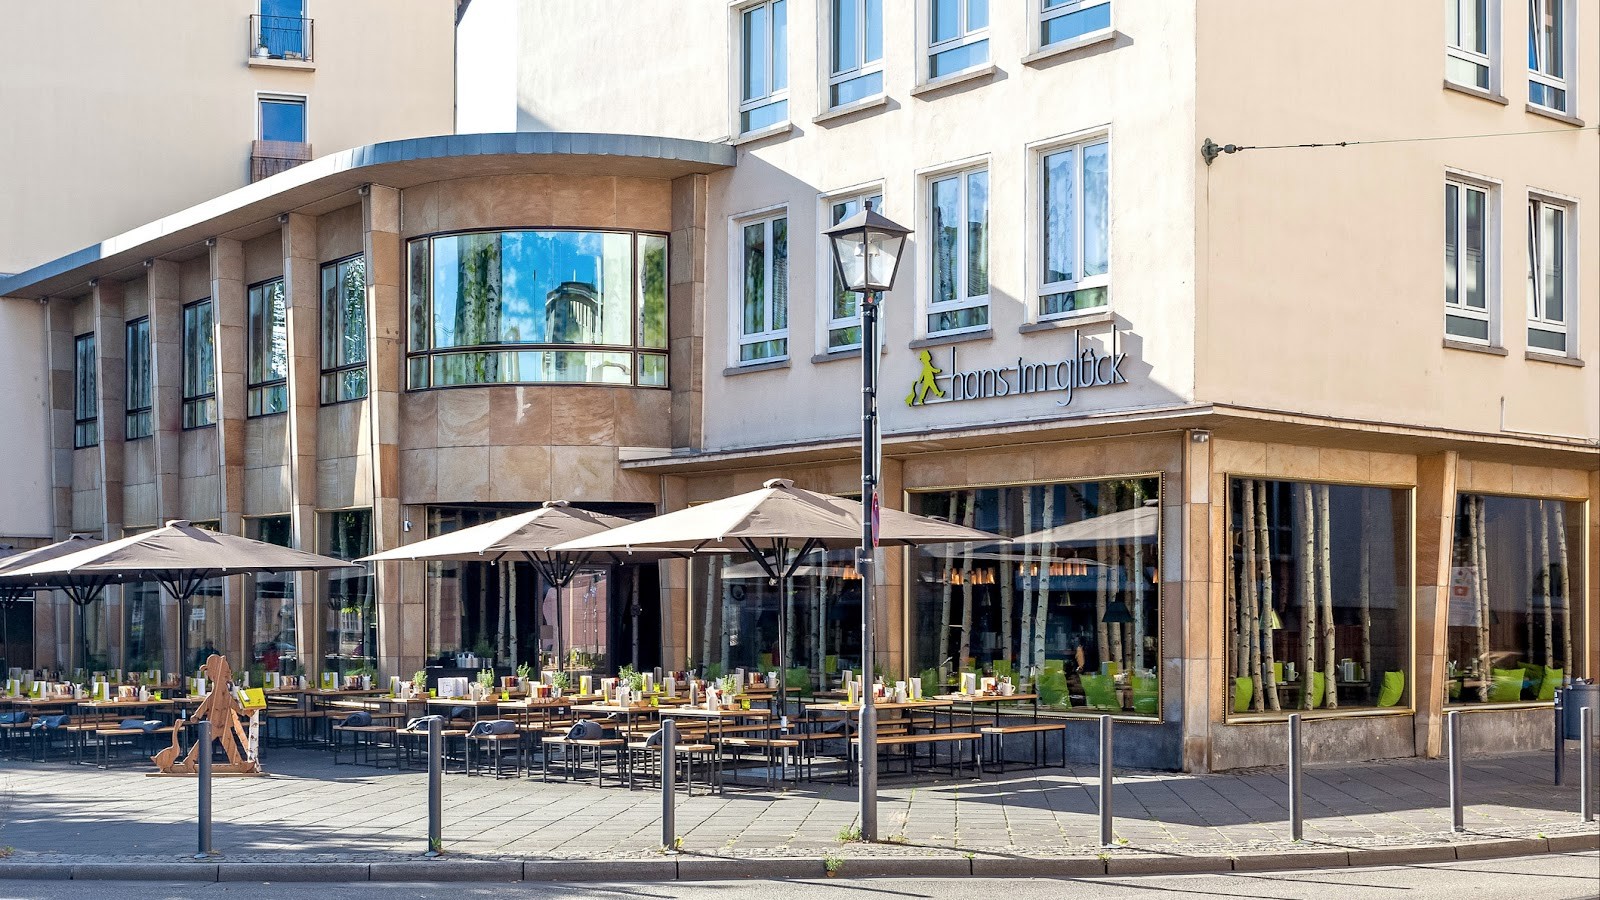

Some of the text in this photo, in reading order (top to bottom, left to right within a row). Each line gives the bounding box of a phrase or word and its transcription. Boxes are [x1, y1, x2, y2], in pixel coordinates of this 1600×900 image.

[951, 325, 1128, 406] hans im glück
